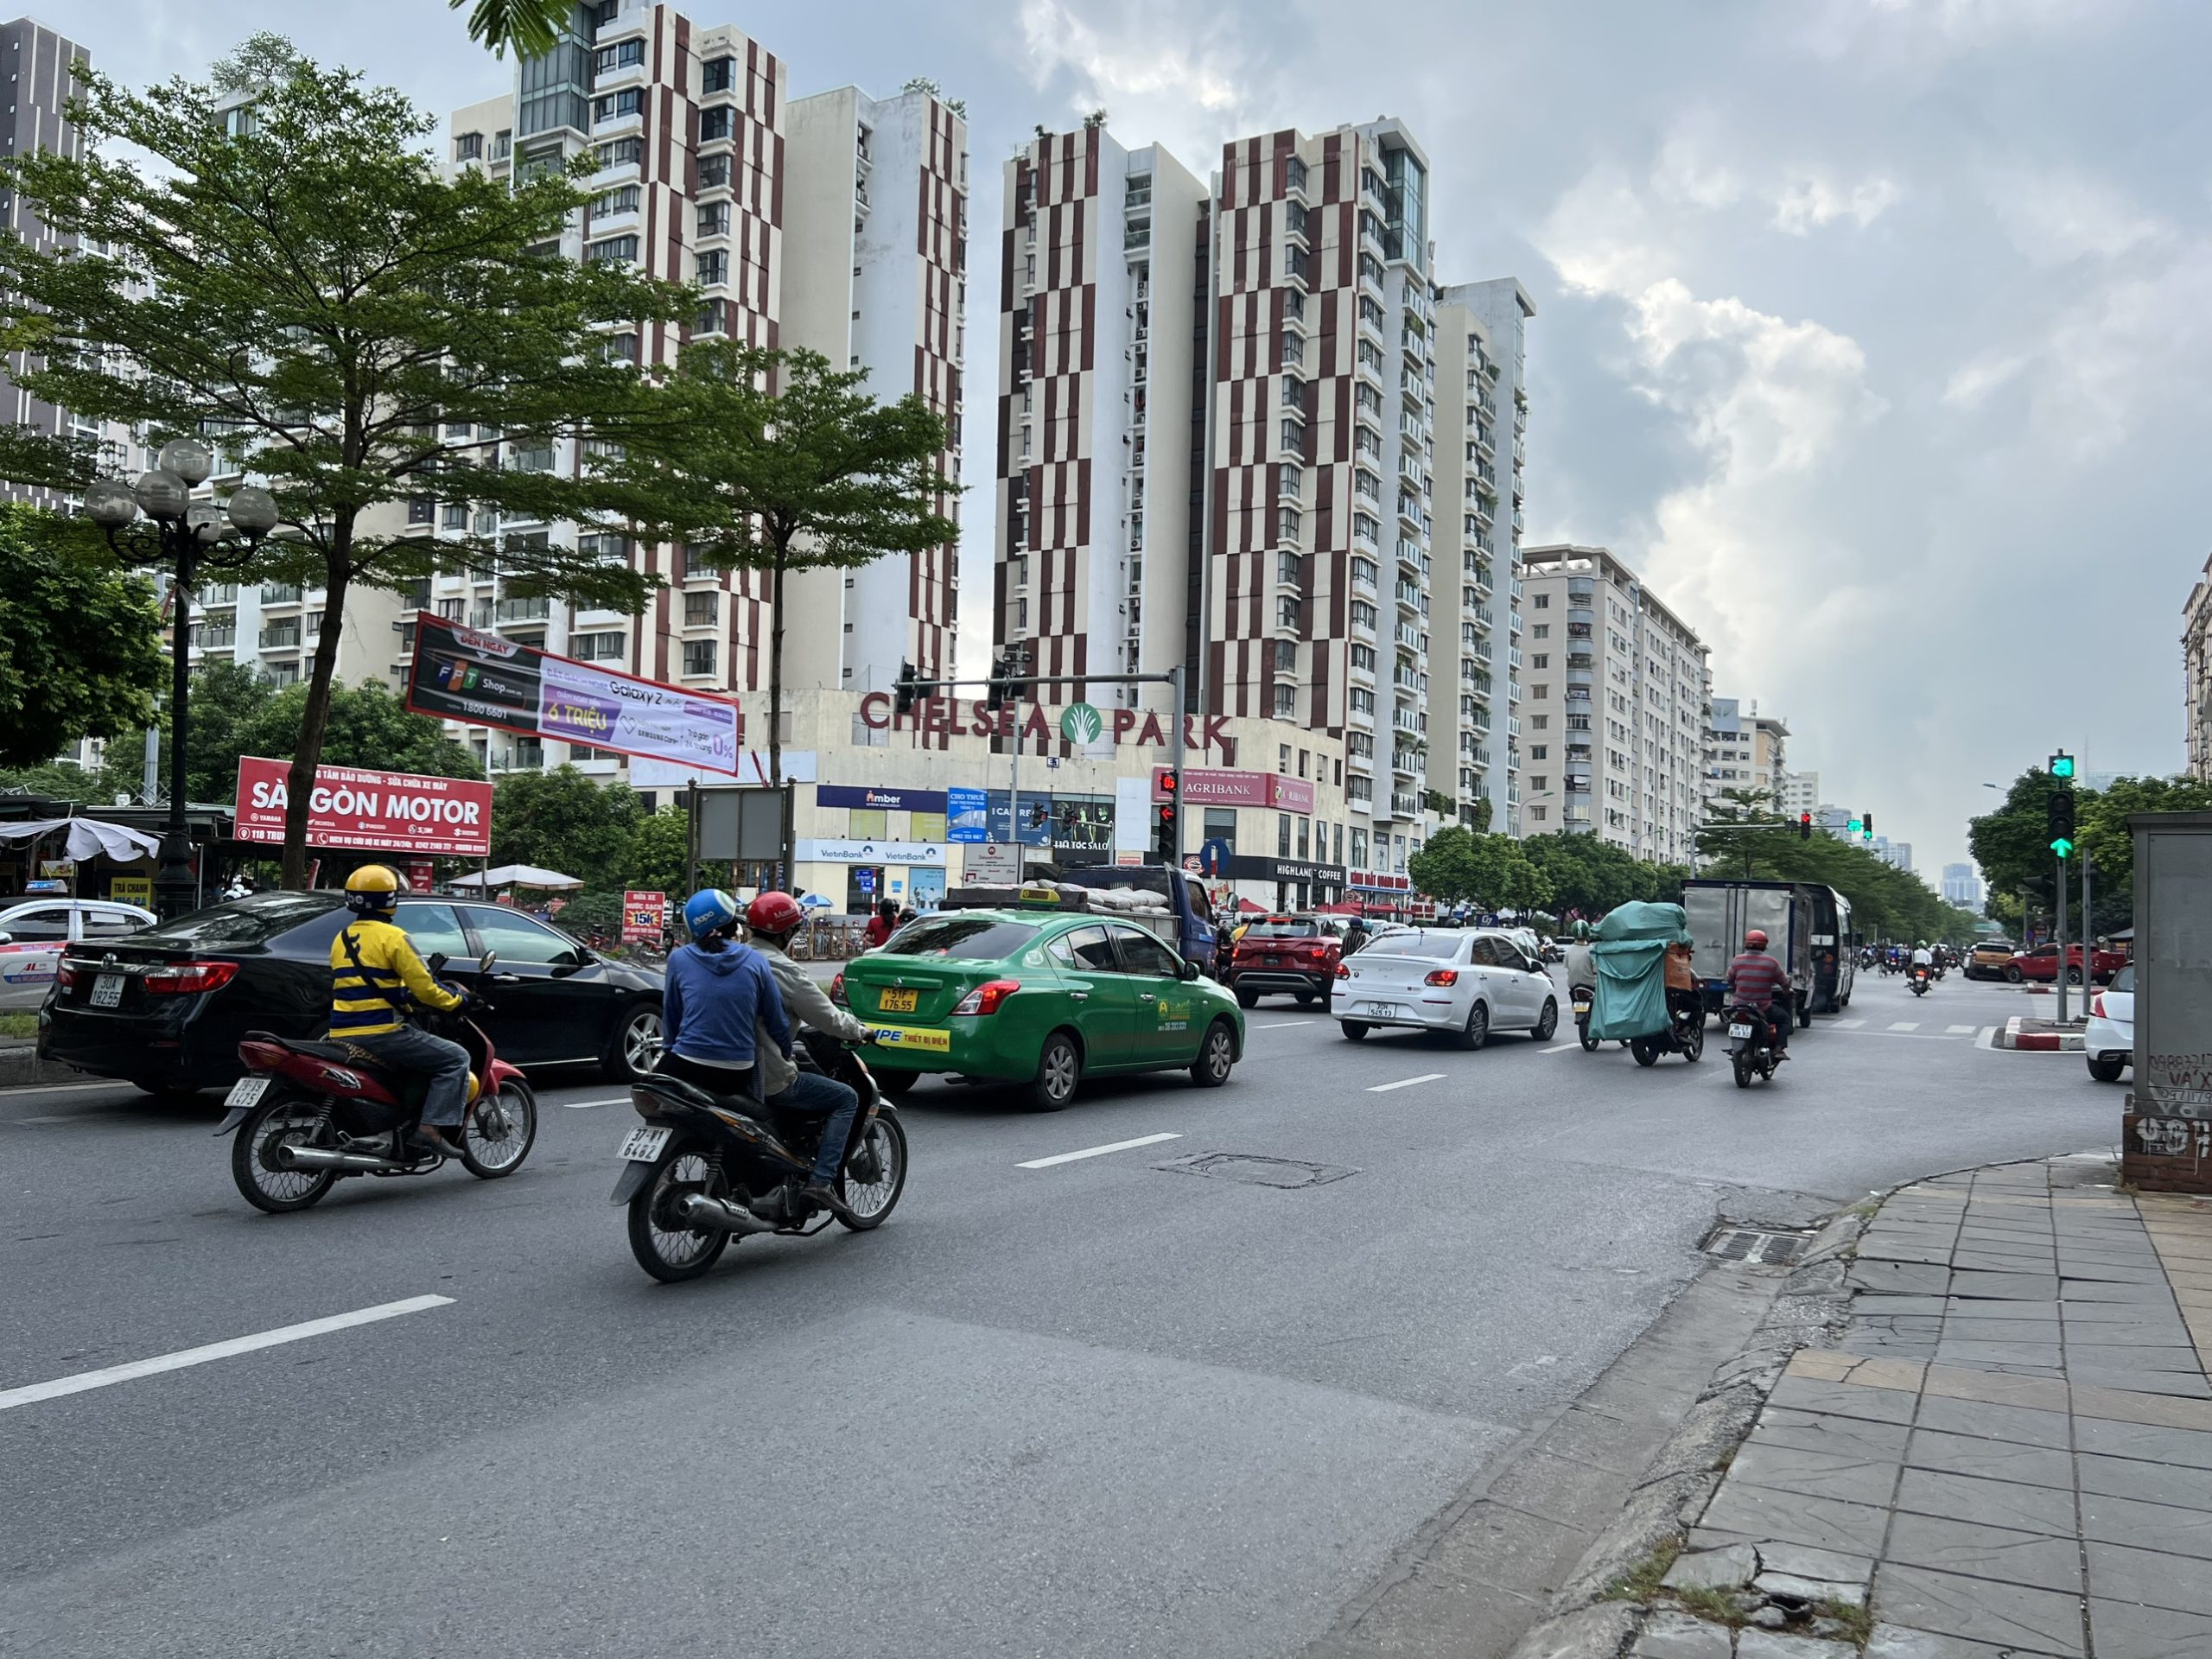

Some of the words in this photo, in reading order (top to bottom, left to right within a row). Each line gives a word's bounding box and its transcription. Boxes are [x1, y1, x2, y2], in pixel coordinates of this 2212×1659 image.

[483, 639, 510, 655] NGAY
[482, 678, 506, 695] Shop
[609, 681, 654, 707] Galaxy
[655, 692, 664, 706] Z
[462, 701, 484, 716] 1800
[548, 702, 559, 721] 6
[564, 705, 607, 734] TRIỆU
[860, 691, 1052, 741] CHELSEA
[1114, 708, 1234, 751] PARK
[1184, 783, 1251, 795] AGRIBANK
[251, 778, 289, 810] SÀ
[309, 784, 378, 818] GÒN
[385, 793, 480, 825] MOTOR
[996, 807, 1012, 817] CA
[1088, 842, 1110, 851] SALO
[821, 849, 863, 859] VietinBank
[886, 852, 927, 861] VietinBank
[1276, 864, 1317, 878] HIGHLAND
[1318, 869, 1341, 881] COFFEE
[346, 892, 364, 906] be
[633, 912, 654, 925] 15k
[1481, 914, 1493, 926] G7
[100, 976, 118, 990] 30A
[884, 999, 913, 1011] 176.55
